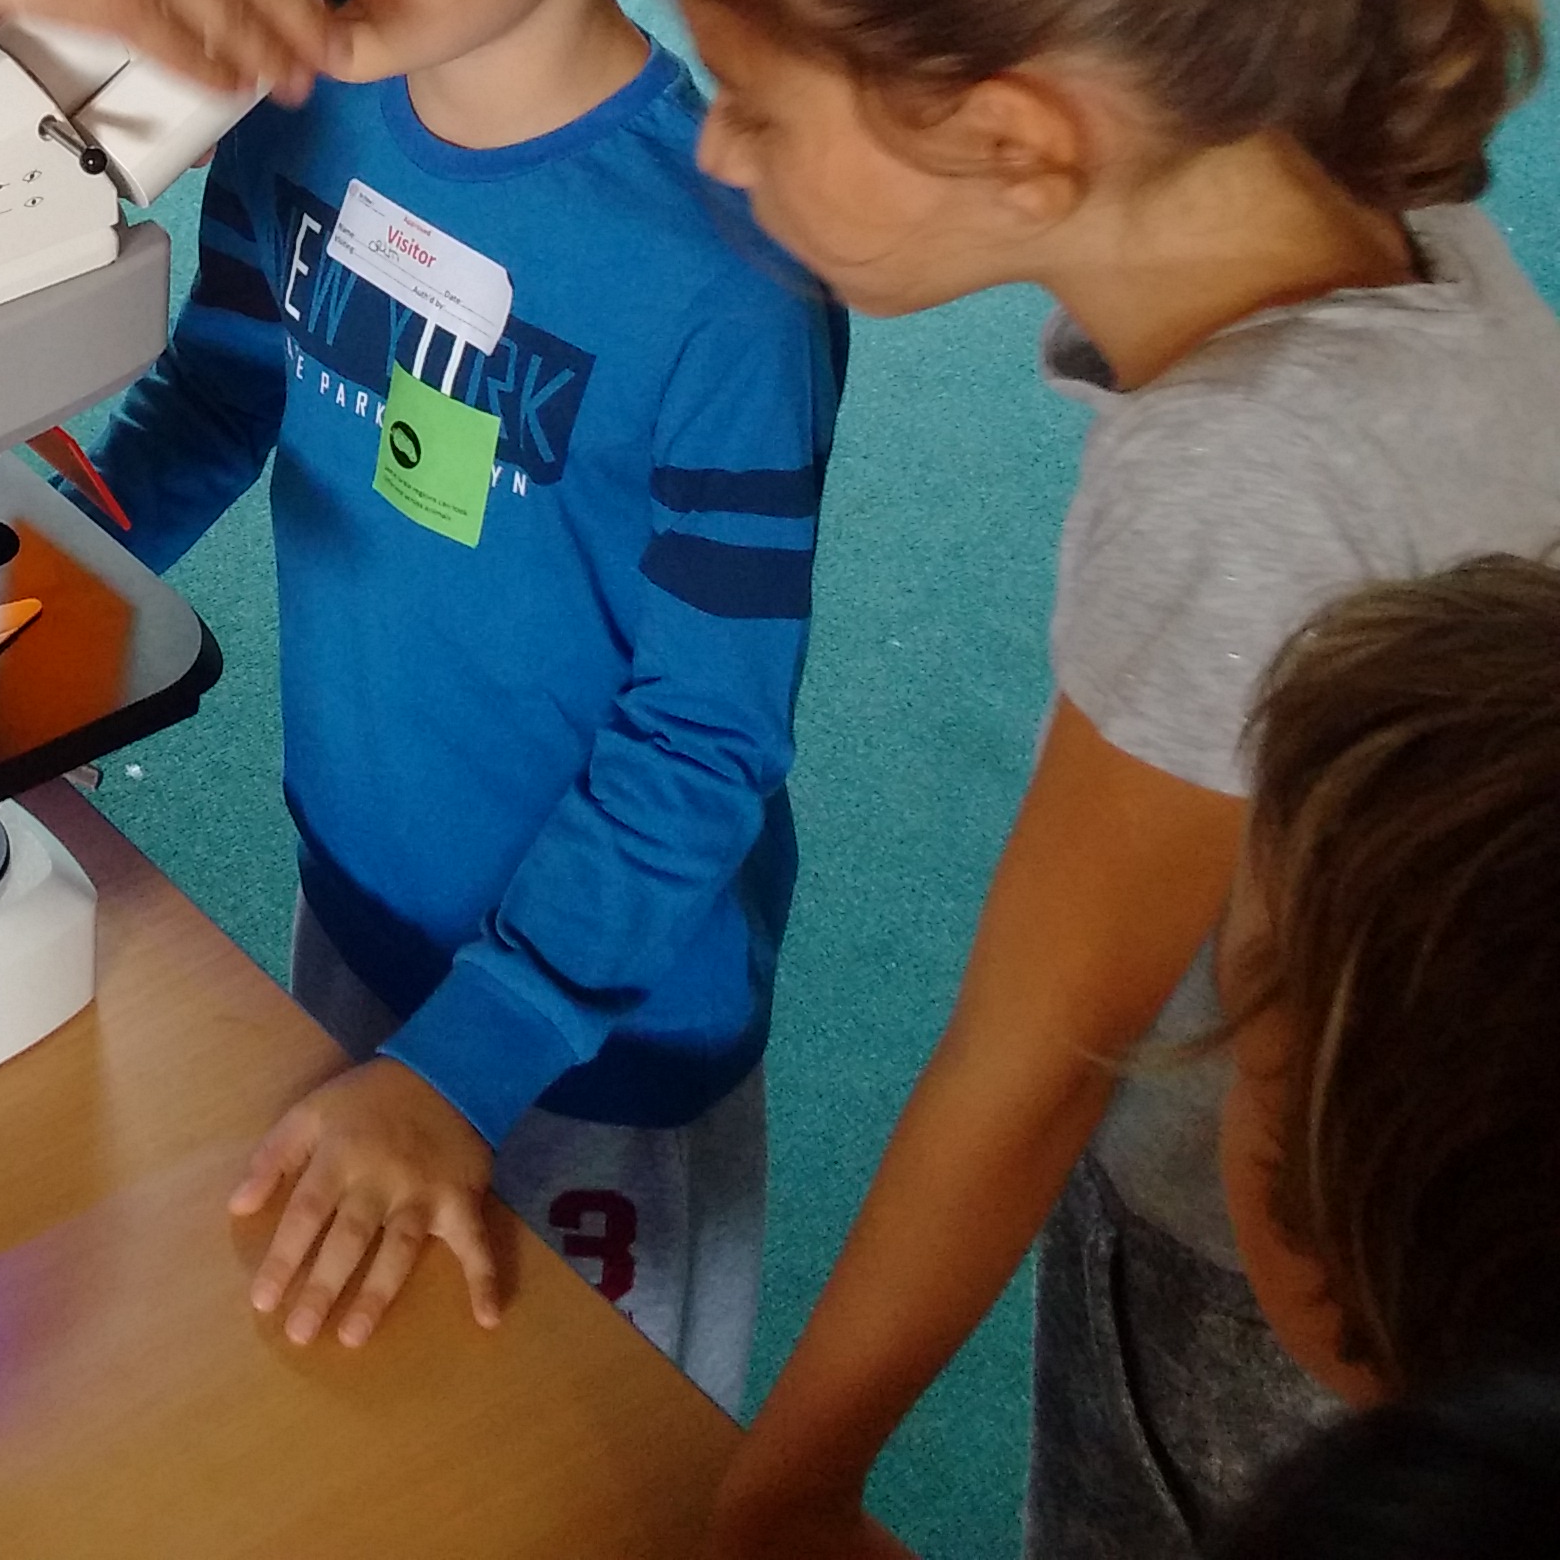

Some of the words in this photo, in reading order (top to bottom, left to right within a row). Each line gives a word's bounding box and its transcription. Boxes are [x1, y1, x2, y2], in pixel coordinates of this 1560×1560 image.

[387, 225, 437, 268] Visitor
[444, 290, 462, 304] Date
[319, 371, 386, 429] PARK
[384, 296, 576, 463] YRK
